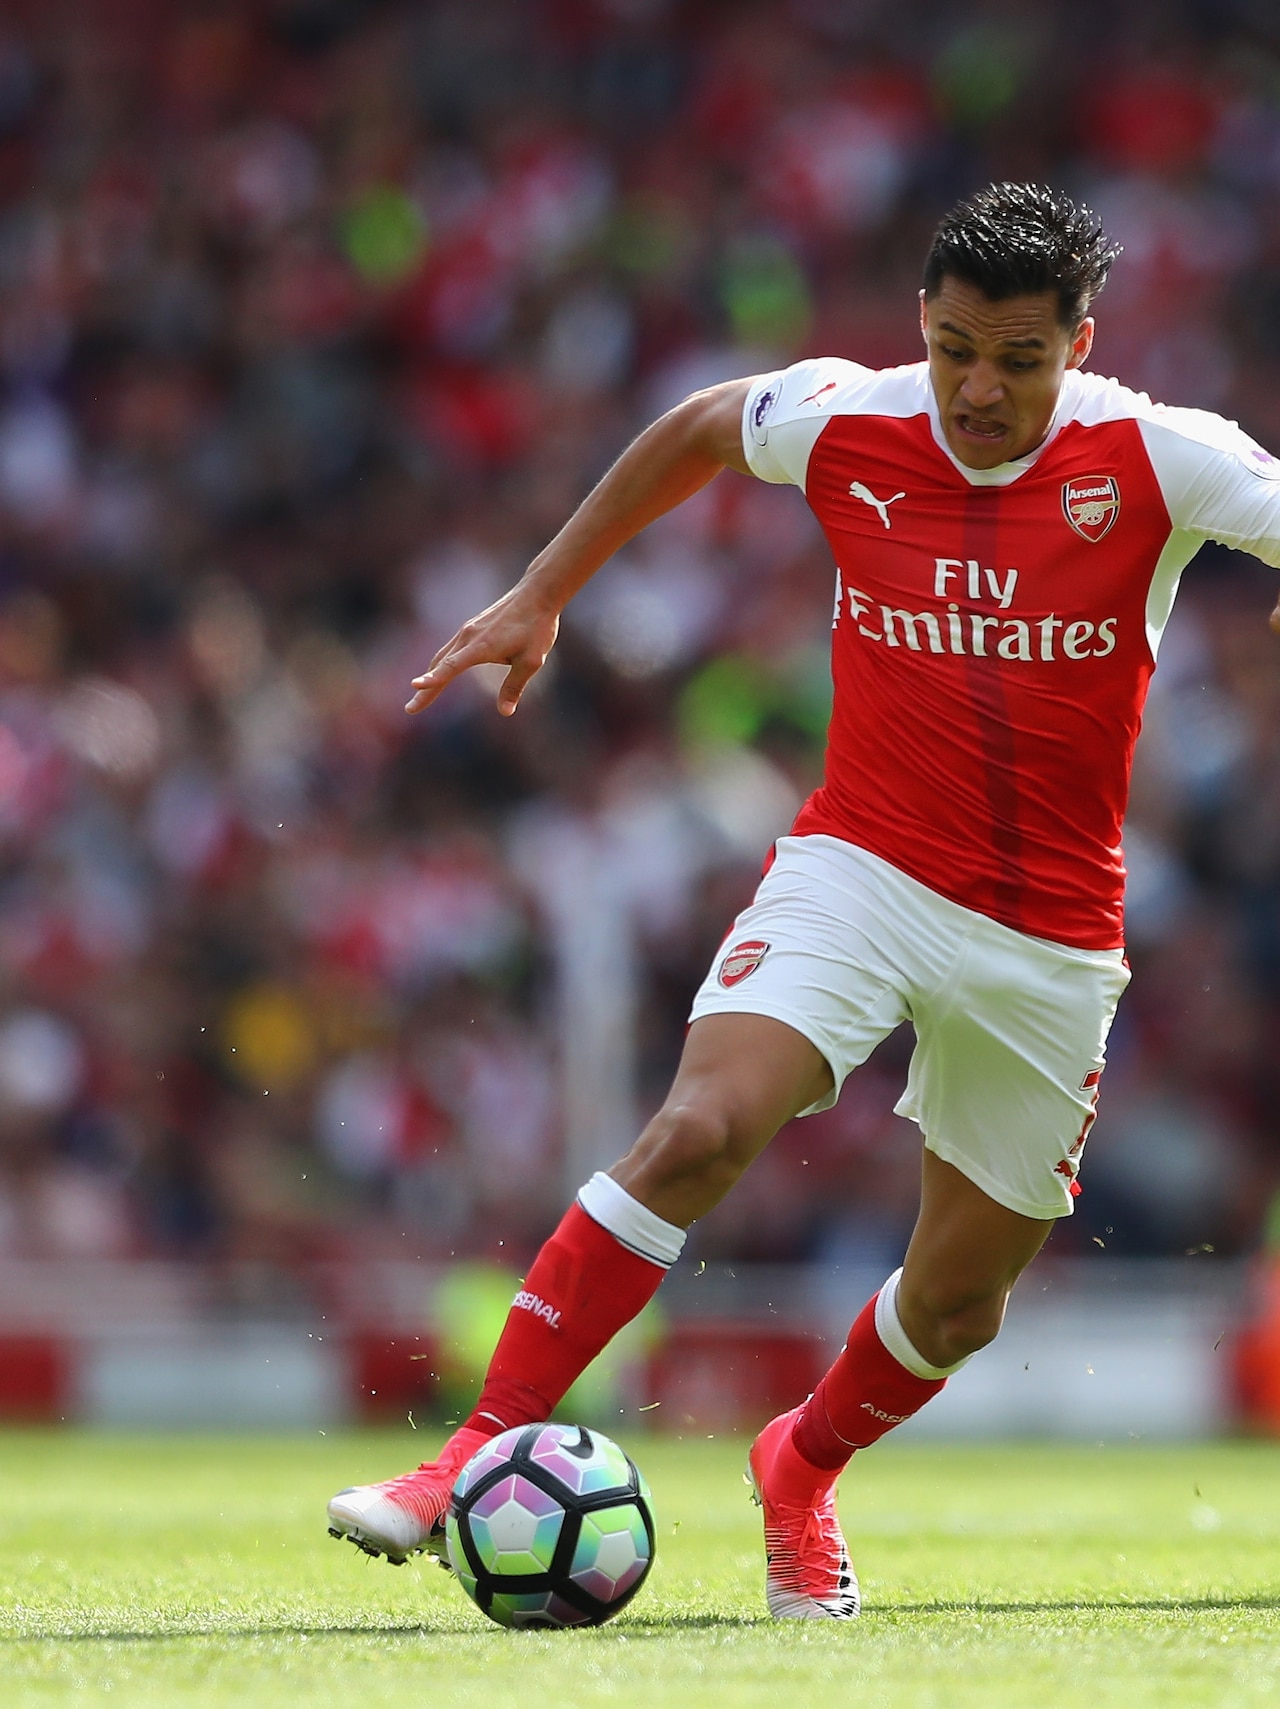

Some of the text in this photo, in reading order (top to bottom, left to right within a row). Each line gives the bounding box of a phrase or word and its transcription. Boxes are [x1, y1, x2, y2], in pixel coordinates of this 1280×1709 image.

[1069, 484, 1112, 500] Arsenal
[934, 558, 1019, 608] Fly
[847, 586, 1118, 662] Emirates
